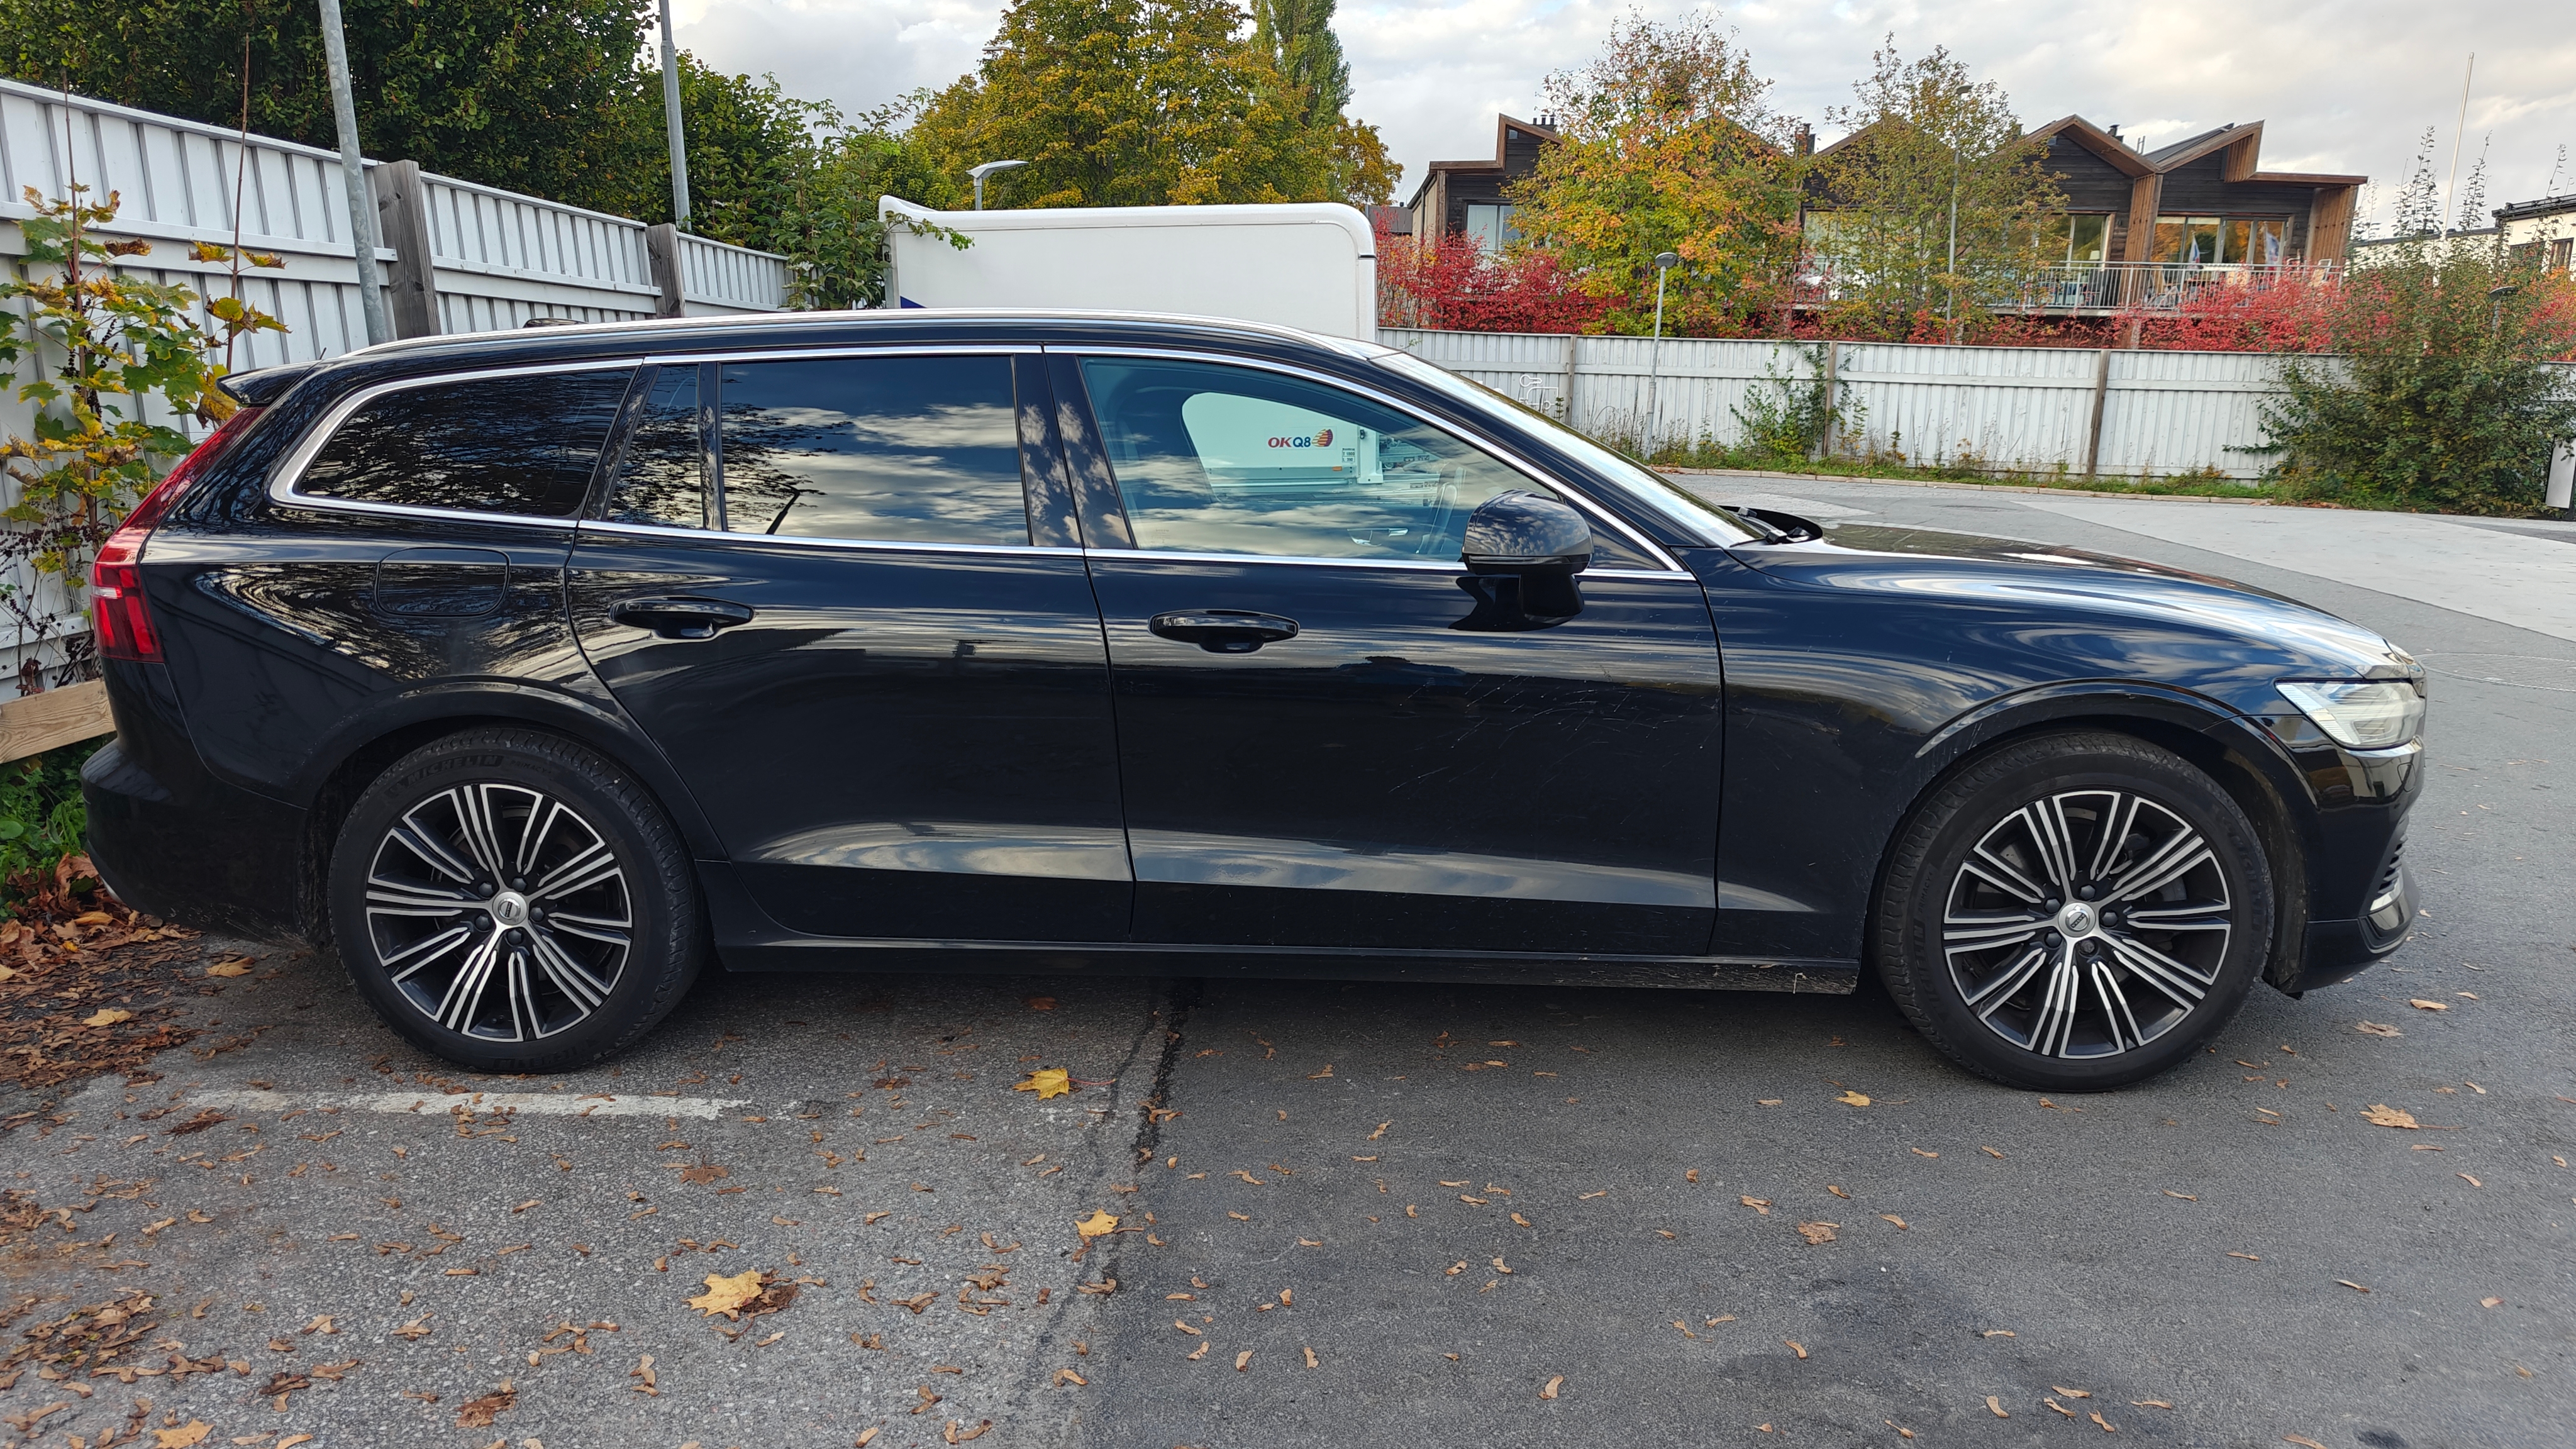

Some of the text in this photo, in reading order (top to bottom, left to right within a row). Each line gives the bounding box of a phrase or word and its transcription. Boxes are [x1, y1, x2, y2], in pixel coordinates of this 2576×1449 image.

[406, 755, 498, 785] MICHELIN
[510, 759, 547, 773] PRIMACY
[1918, 875, 1932, 913] PRIMACY
[2071, 914, 2085, 927] VOLVO
[1914, 924, 1940, 1009] MICHELIN
